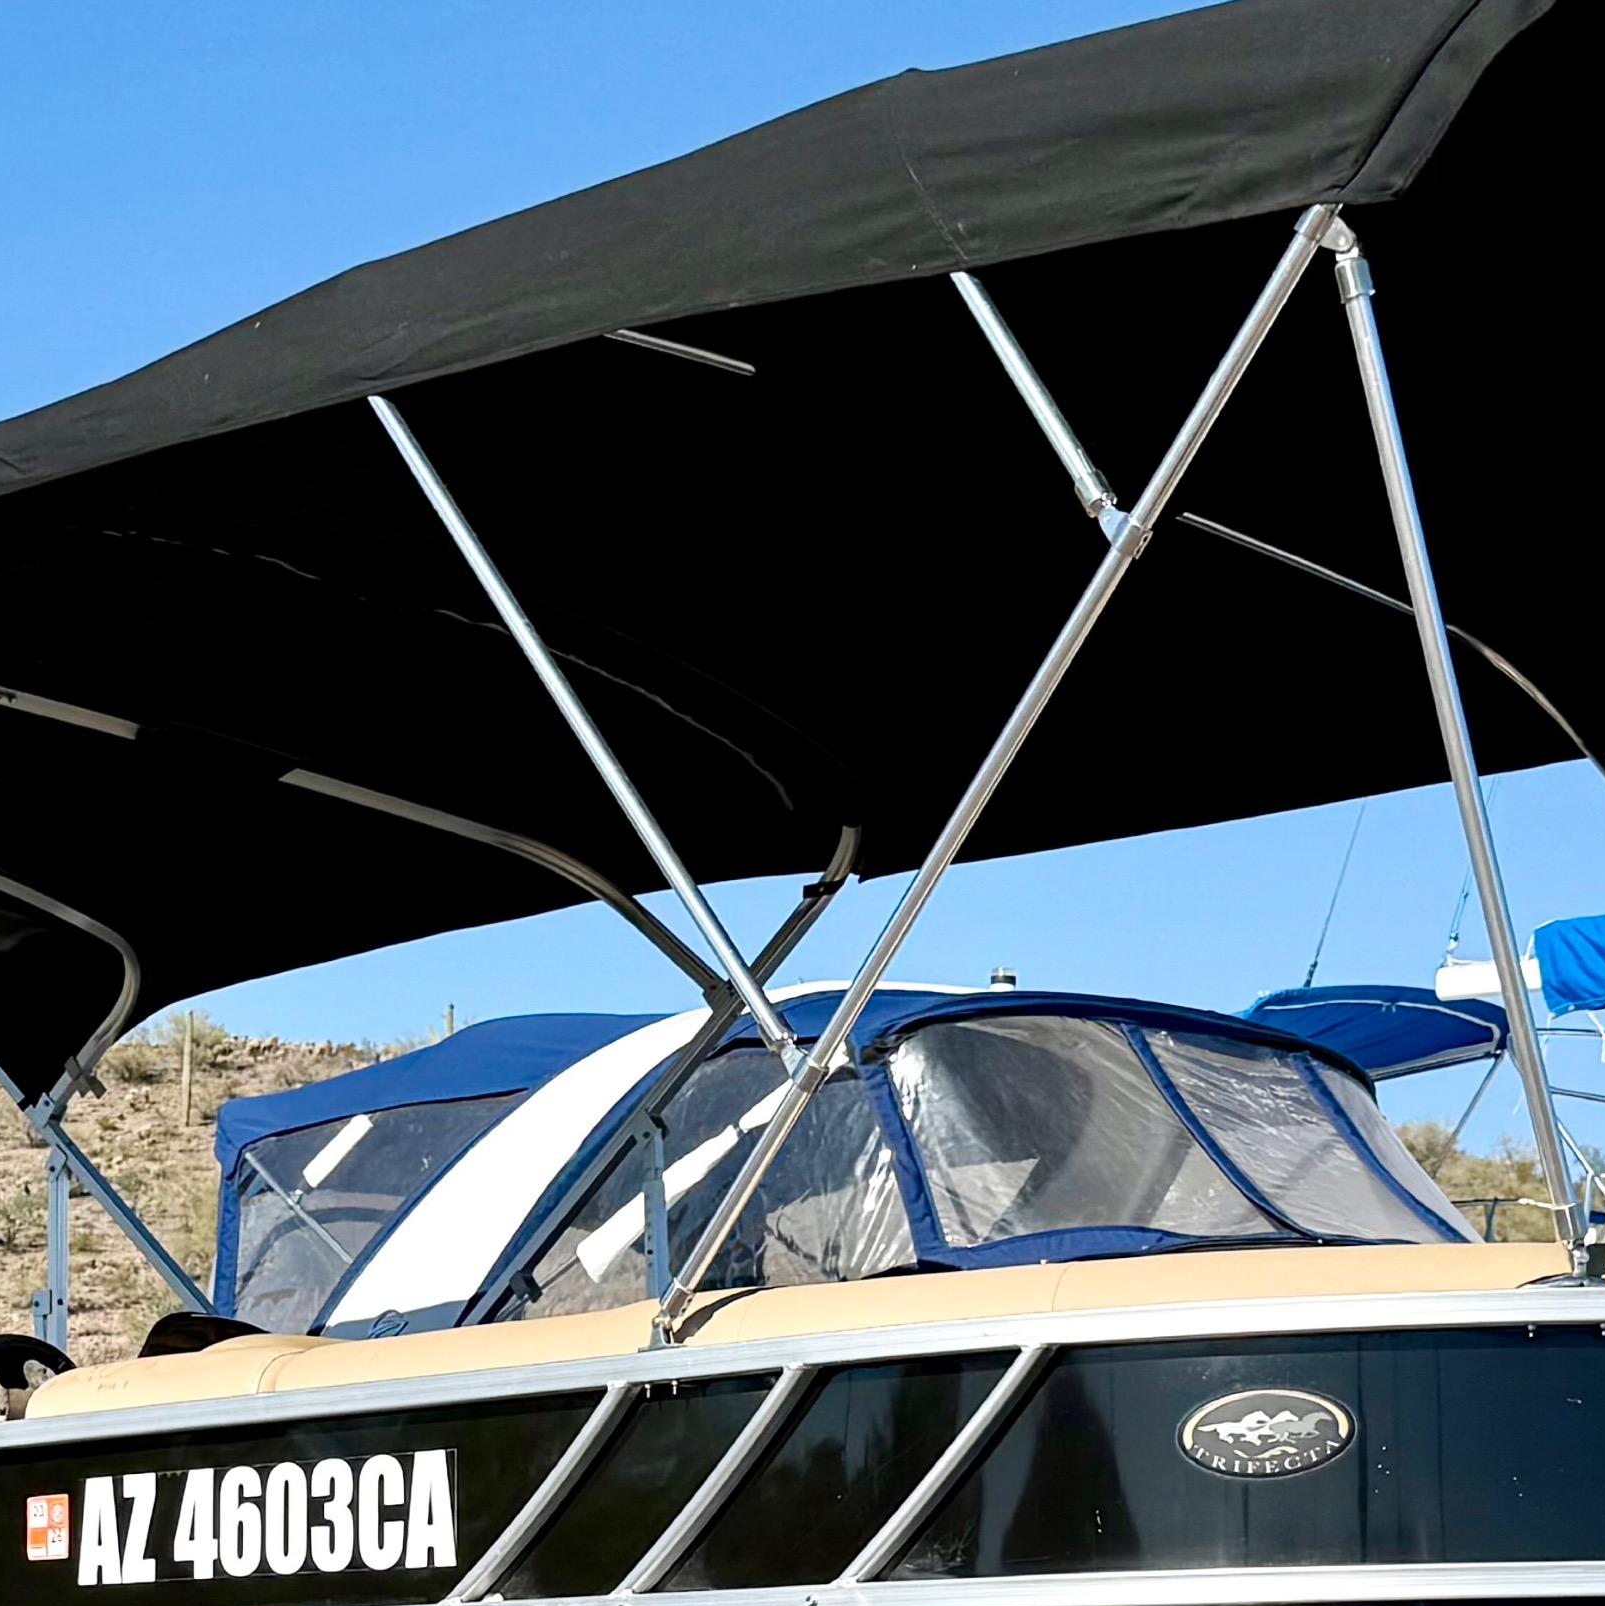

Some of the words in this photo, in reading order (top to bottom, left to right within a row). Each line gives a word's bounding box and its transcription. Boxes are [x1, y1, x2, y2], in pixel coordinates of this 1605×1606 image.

[1194, 1438, 1341, 1475] TRIFECTA
[77, 1472, 157, 1587] AZ
[173, 1447, 458, 1581] 4603CA
